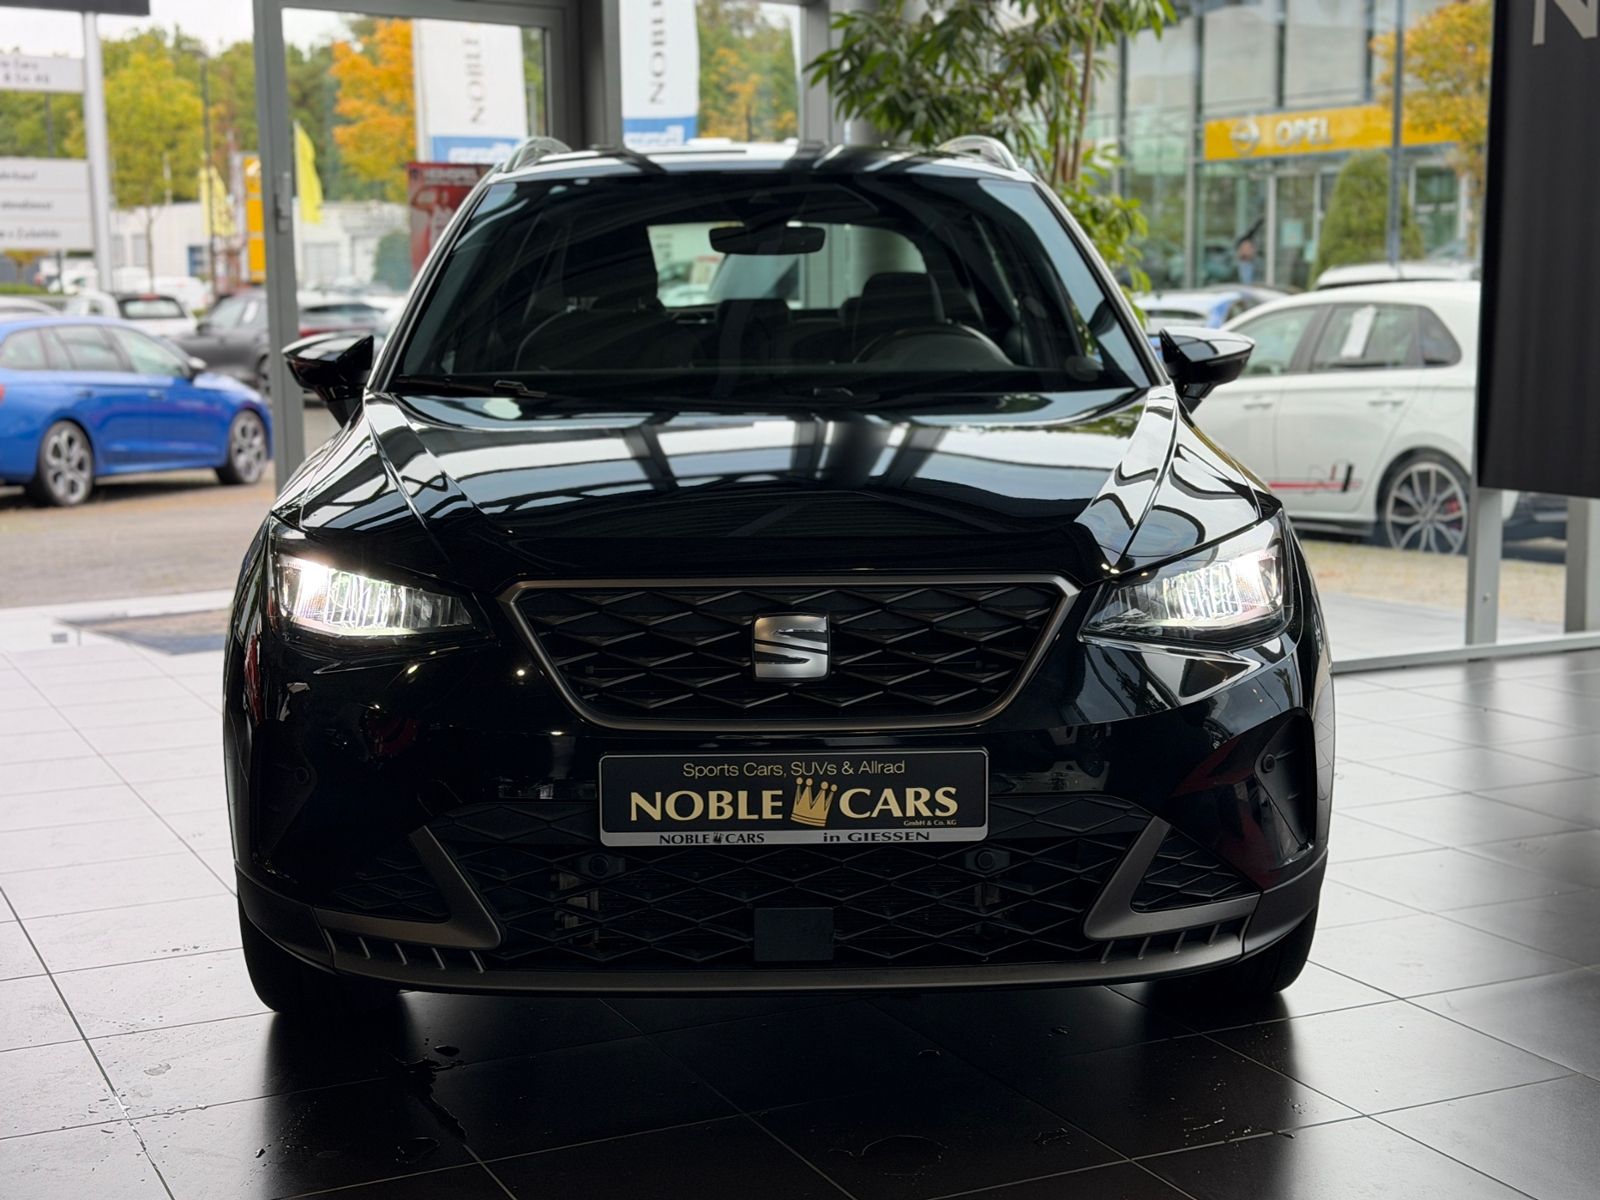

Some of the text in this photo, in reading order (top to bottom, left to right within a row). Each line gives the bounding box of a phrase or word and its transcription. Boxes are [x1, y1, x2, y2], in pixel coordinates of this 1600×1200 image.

[1275, 116, 1334, 147] OPEL
[682, 759, 905, 779] Sports Cars, SUVs & Allrad
[630, 786, 959, 822] NOBLE CARS
[903, 819, 926, 827] GmbH
[946, 818, 957, 826] KG
[659, 832, 765, 845] NOBLE CARS
[823, 831, 930, 843] in GIESSEN
